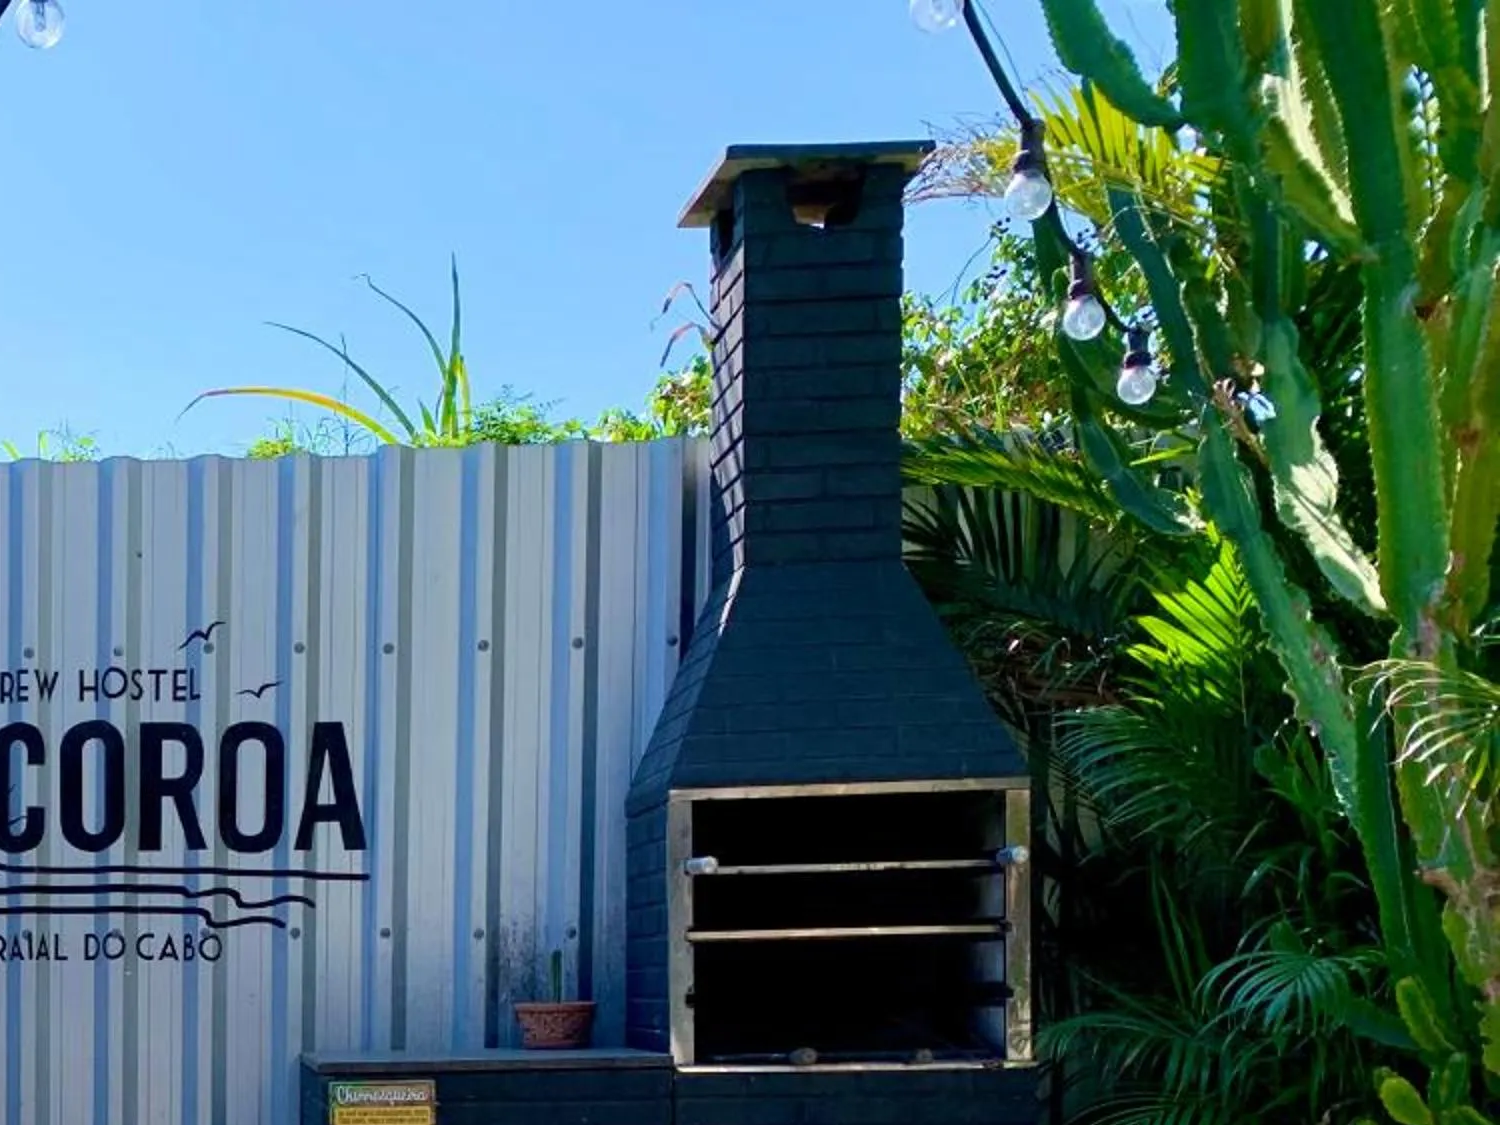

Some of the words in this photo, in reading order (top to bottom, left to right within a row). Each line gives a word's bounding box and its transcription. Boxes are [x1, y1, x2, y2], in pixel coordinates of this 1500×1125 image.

[79, 666, 202, 702] HOSTEL
[84, 933, 125, 962] DO
[136, 933, 224, 962] CABO
